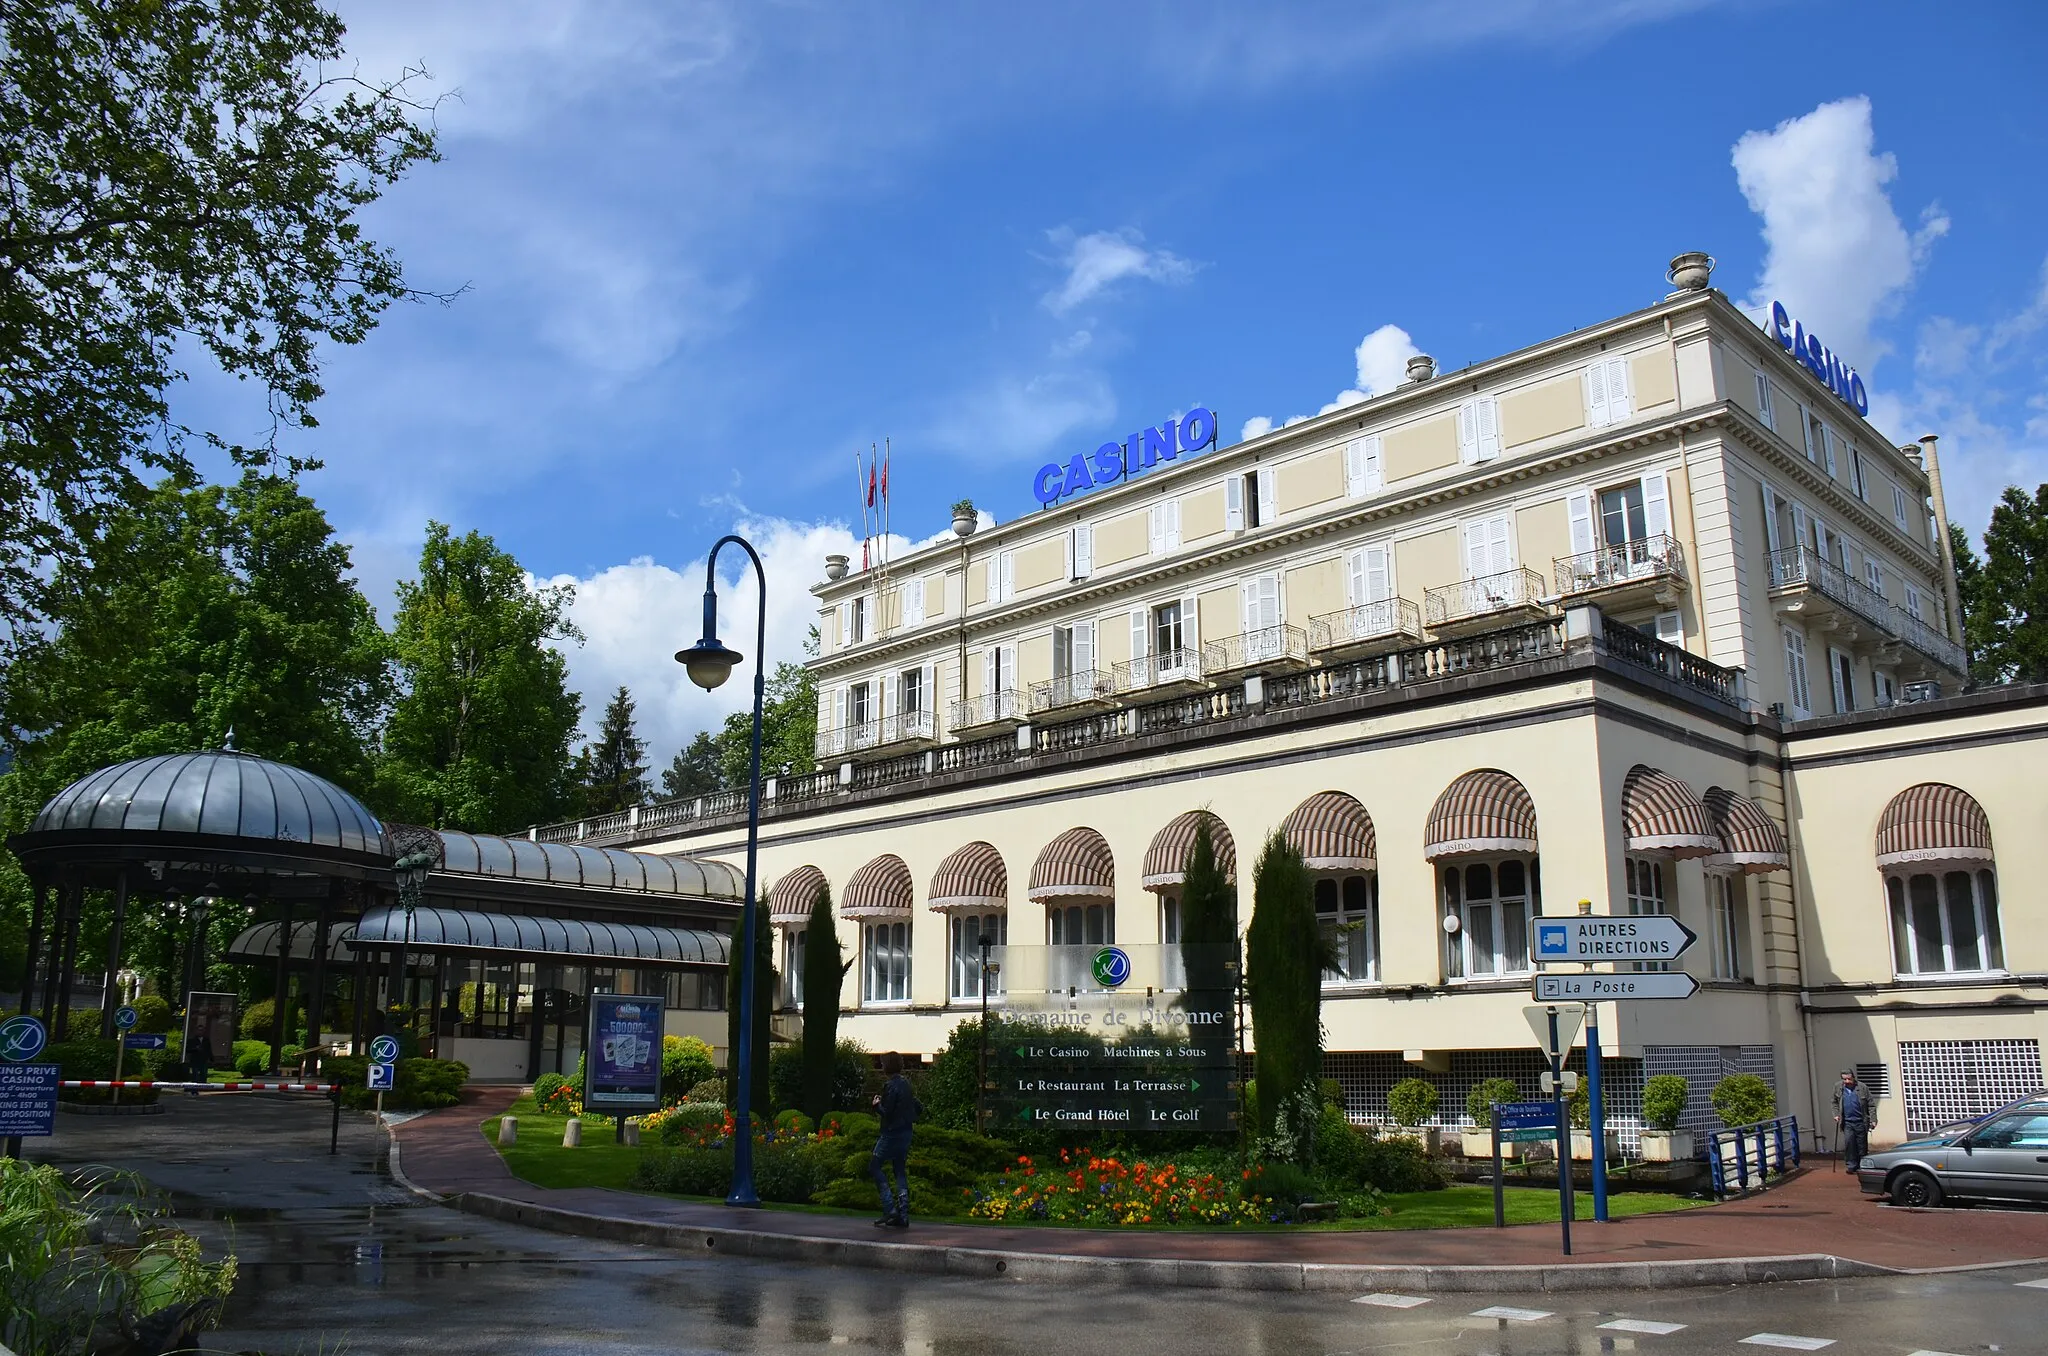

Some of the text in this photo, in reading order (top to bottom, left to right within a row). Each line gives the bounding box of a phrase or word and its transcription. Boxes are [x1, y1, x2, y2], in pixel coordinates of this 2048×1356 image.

[1767, 300, 1868, 417] CASINO
[1034, 407, 1216, 503] CASINO
[1438, 842, 1471, 852] Casino
[1900, 849, 1936, 860] Casino
[1148, 875, 1174, 884] Casino
[1034, 888, 1056, 897] Casino
[1579, 924, 1637, 937] AUTRES
[1579, 941, 1670, 954] DIRECTIONS
[1565, 980, 1635, 993] La Poste
[1001, 1007, 1224, 1026] Domaine de Divonne
[1029, 1046, 1207, 1057] Le Casino Machines à Sous
[26, 1065, 57, 1075] PRIVÉ
[2, 1076, 45, 1084] CASINO
[368, 1065, 385, 1088] P
[1018, 1080, 1186, 1091] Le Restaurant La Terrasse
[20, 1101, 33, 1109] EST
[34, 1101, 49, 1109] MIS
[2, 1110, 51, 1118] DISPOSITION
[1035, 1109, 1200, 1120] Le Grand Hôtel Le Golf
